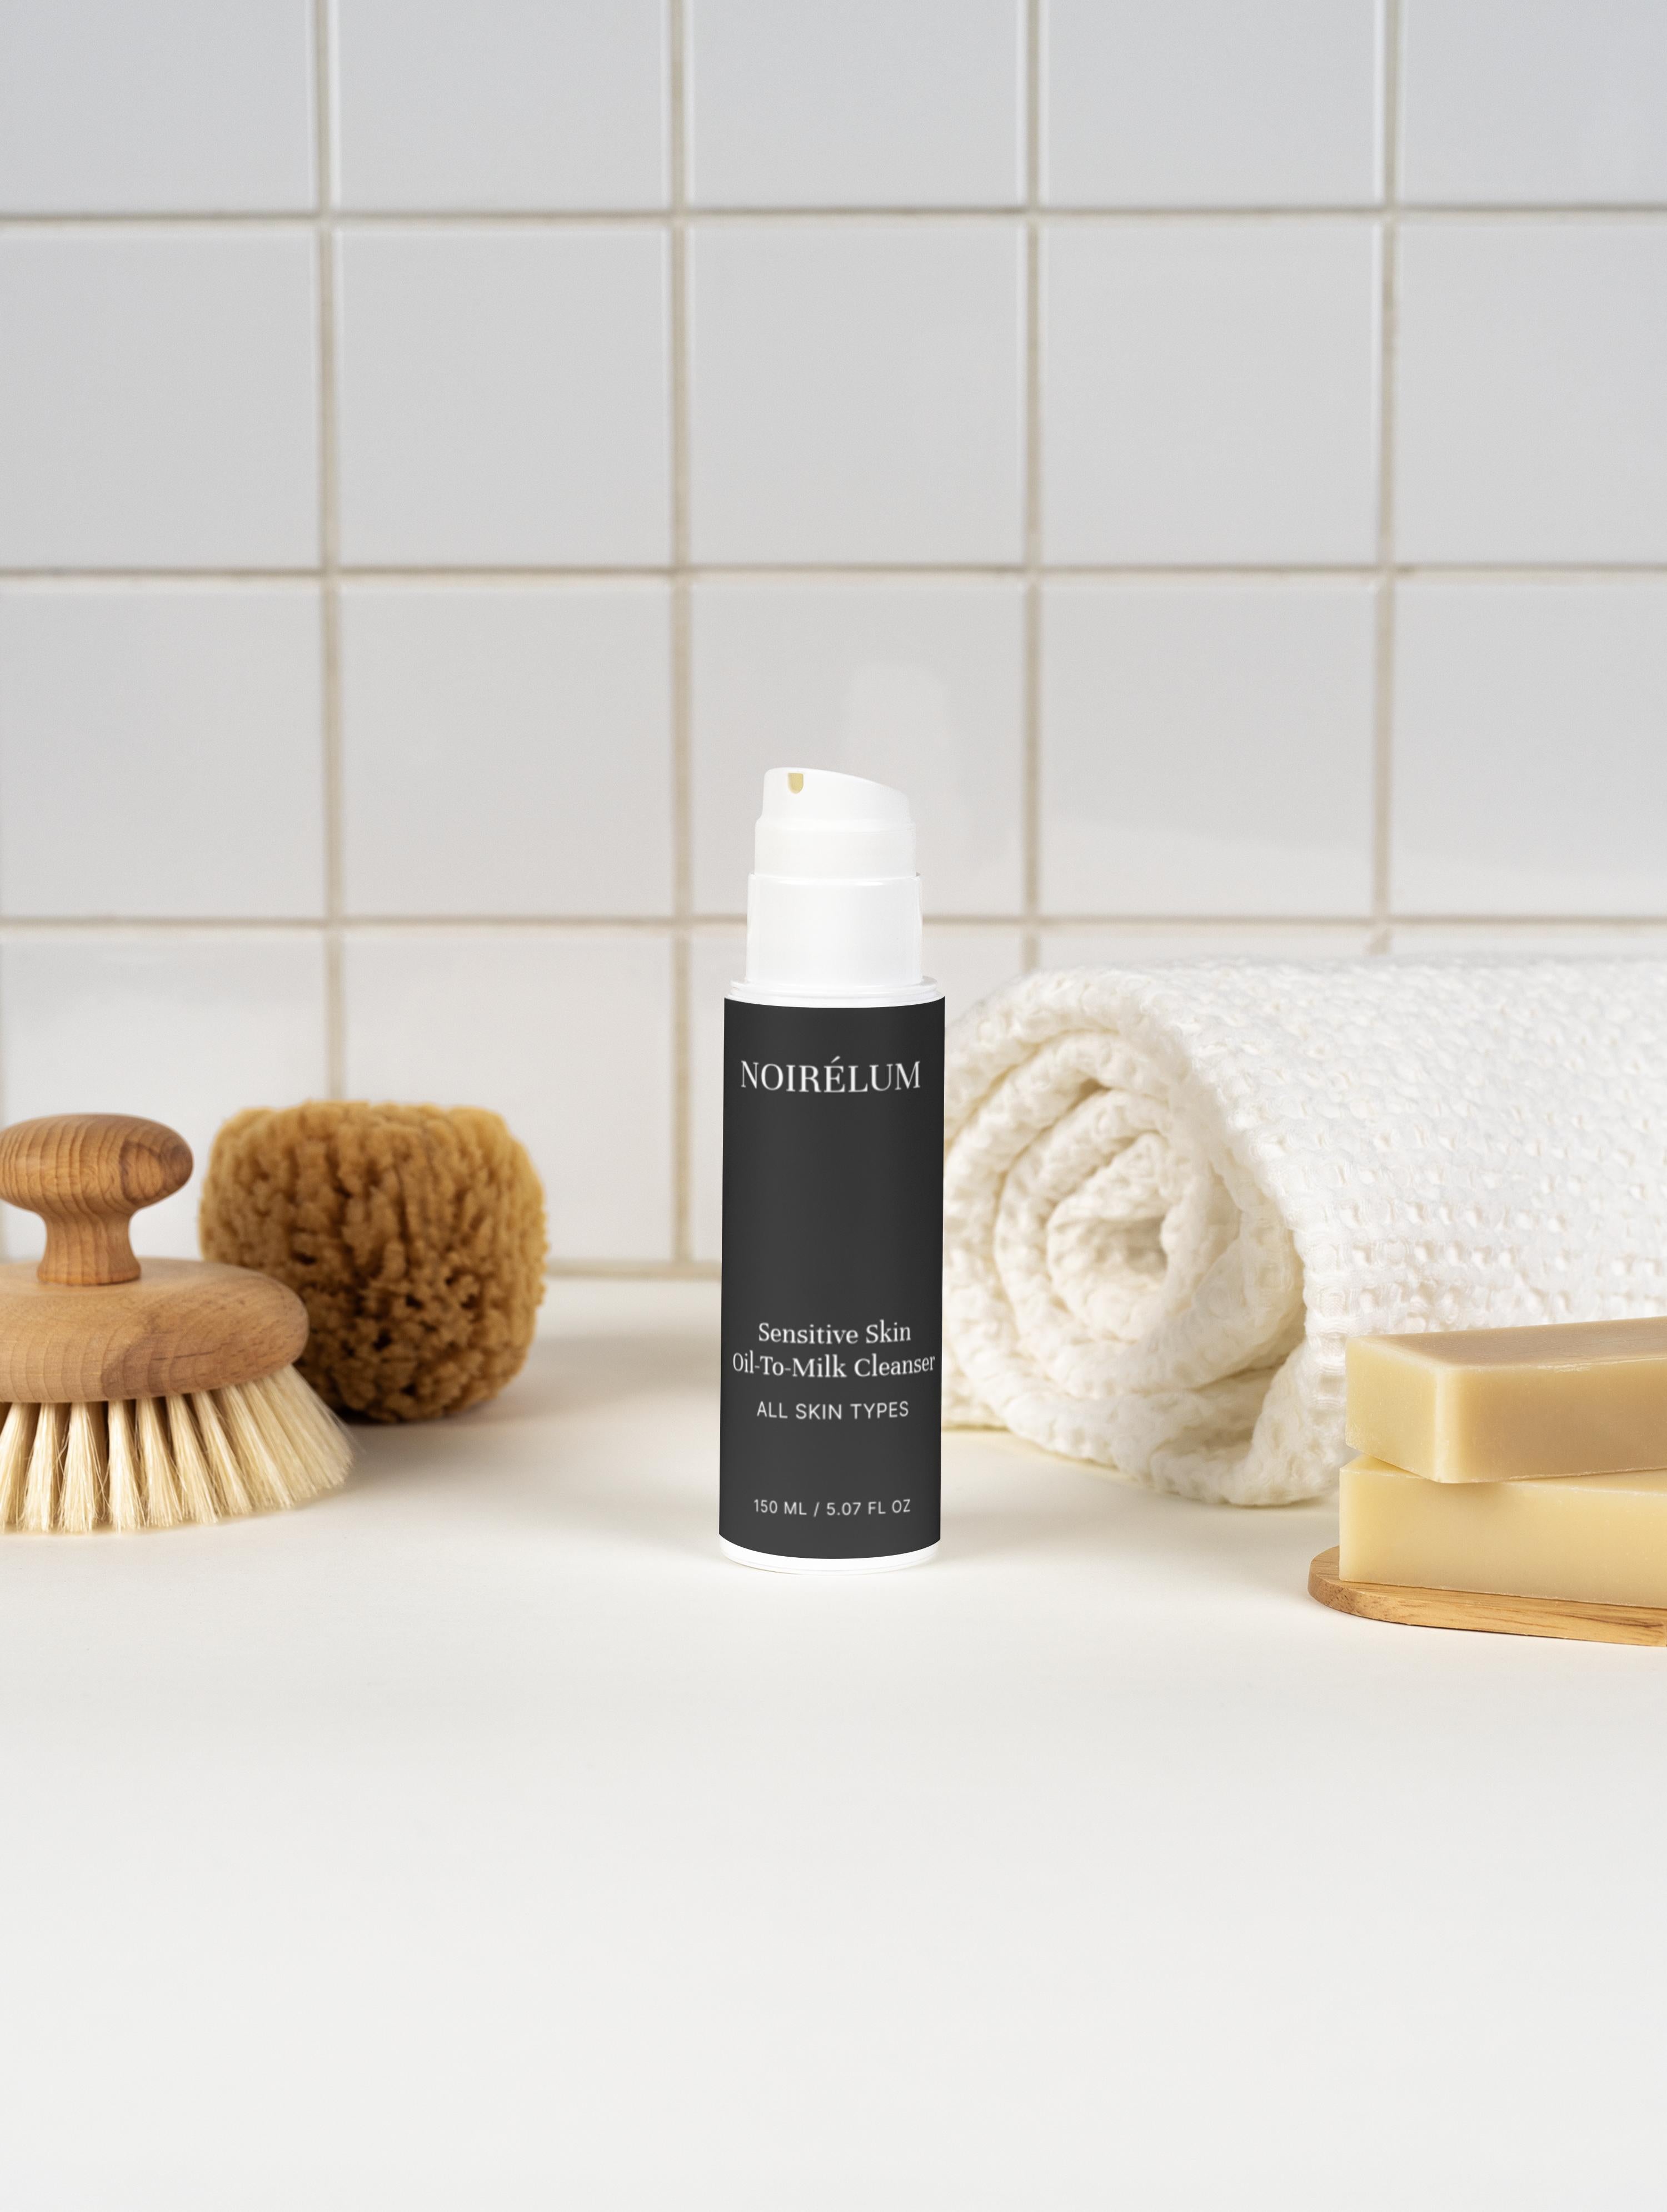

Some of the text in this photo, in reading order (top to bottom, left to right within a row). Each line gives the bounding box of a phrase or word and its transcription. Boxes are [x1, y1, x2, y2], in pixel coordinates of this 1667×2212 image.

[741, 1055, 920, 1093] NOIRÉLUM
[758, 1319, 911, 1345] Sensitive Skin
[732, 1349, 935, 1378] Oil-To-Milk Cleanser
[756, 1400, 909, 1420] ALL SKIN TYPES
[753, 1498, 911, 1518] 150 ML / 5.07 FL OZ
